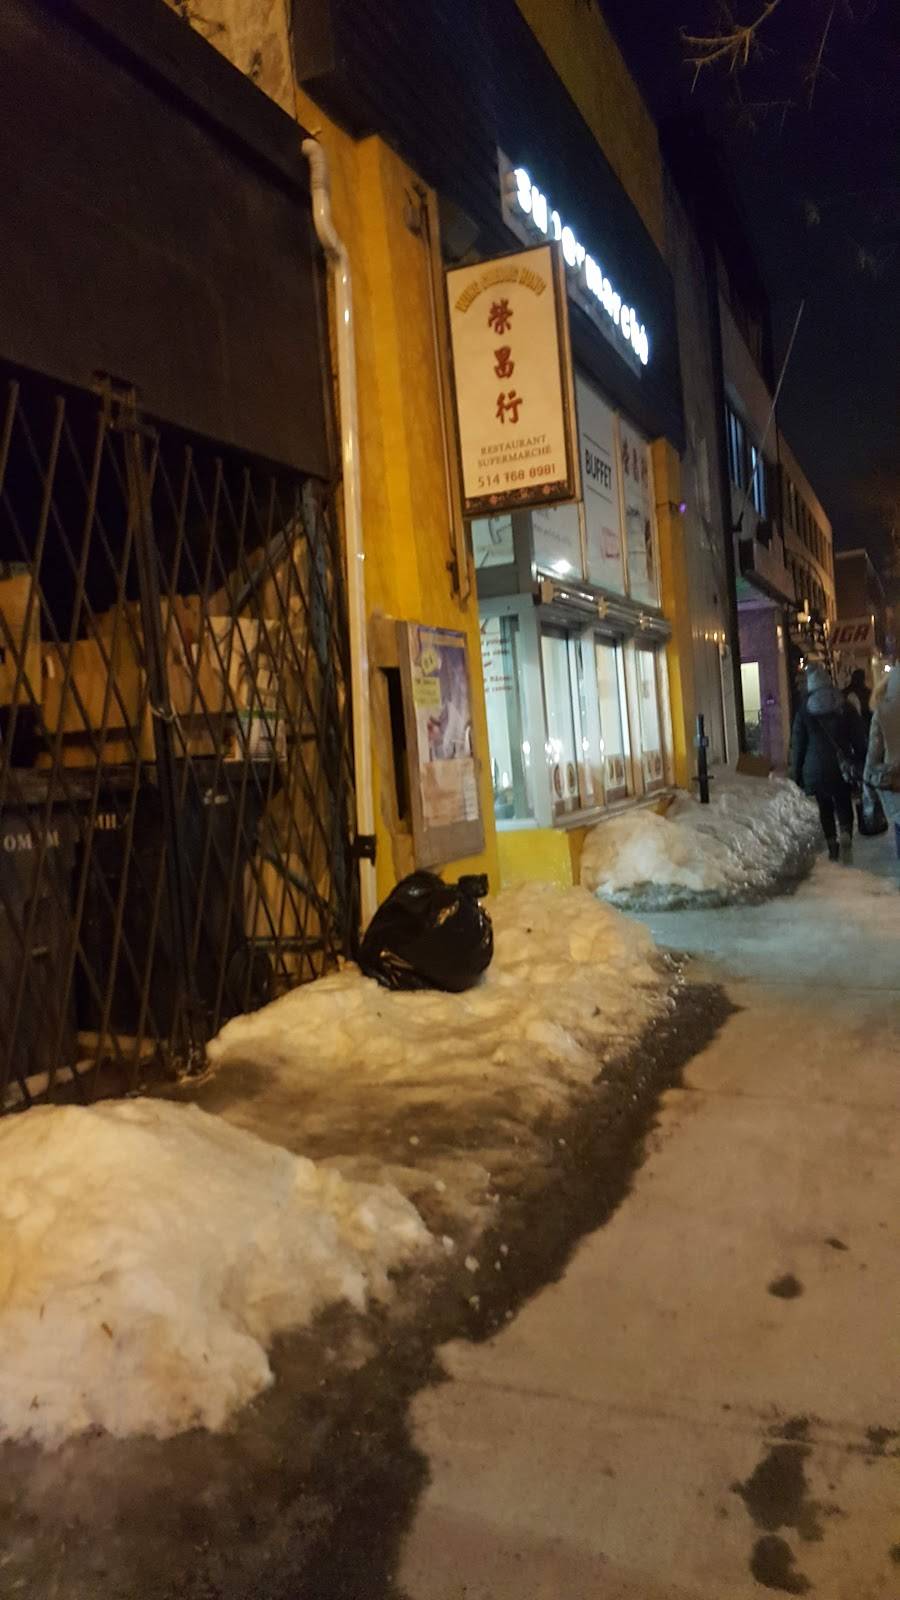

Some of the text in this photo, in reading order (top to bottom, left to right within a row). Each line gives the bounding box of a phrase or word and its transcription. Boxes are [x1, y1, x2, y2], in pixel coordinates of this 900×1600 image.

[480, 434, 547, 455] RESTAURANT
[584, 449, 612, 491] BUFFET
[478, 473, 500, 488] 514
[832, 624, 870, 644] IGA
